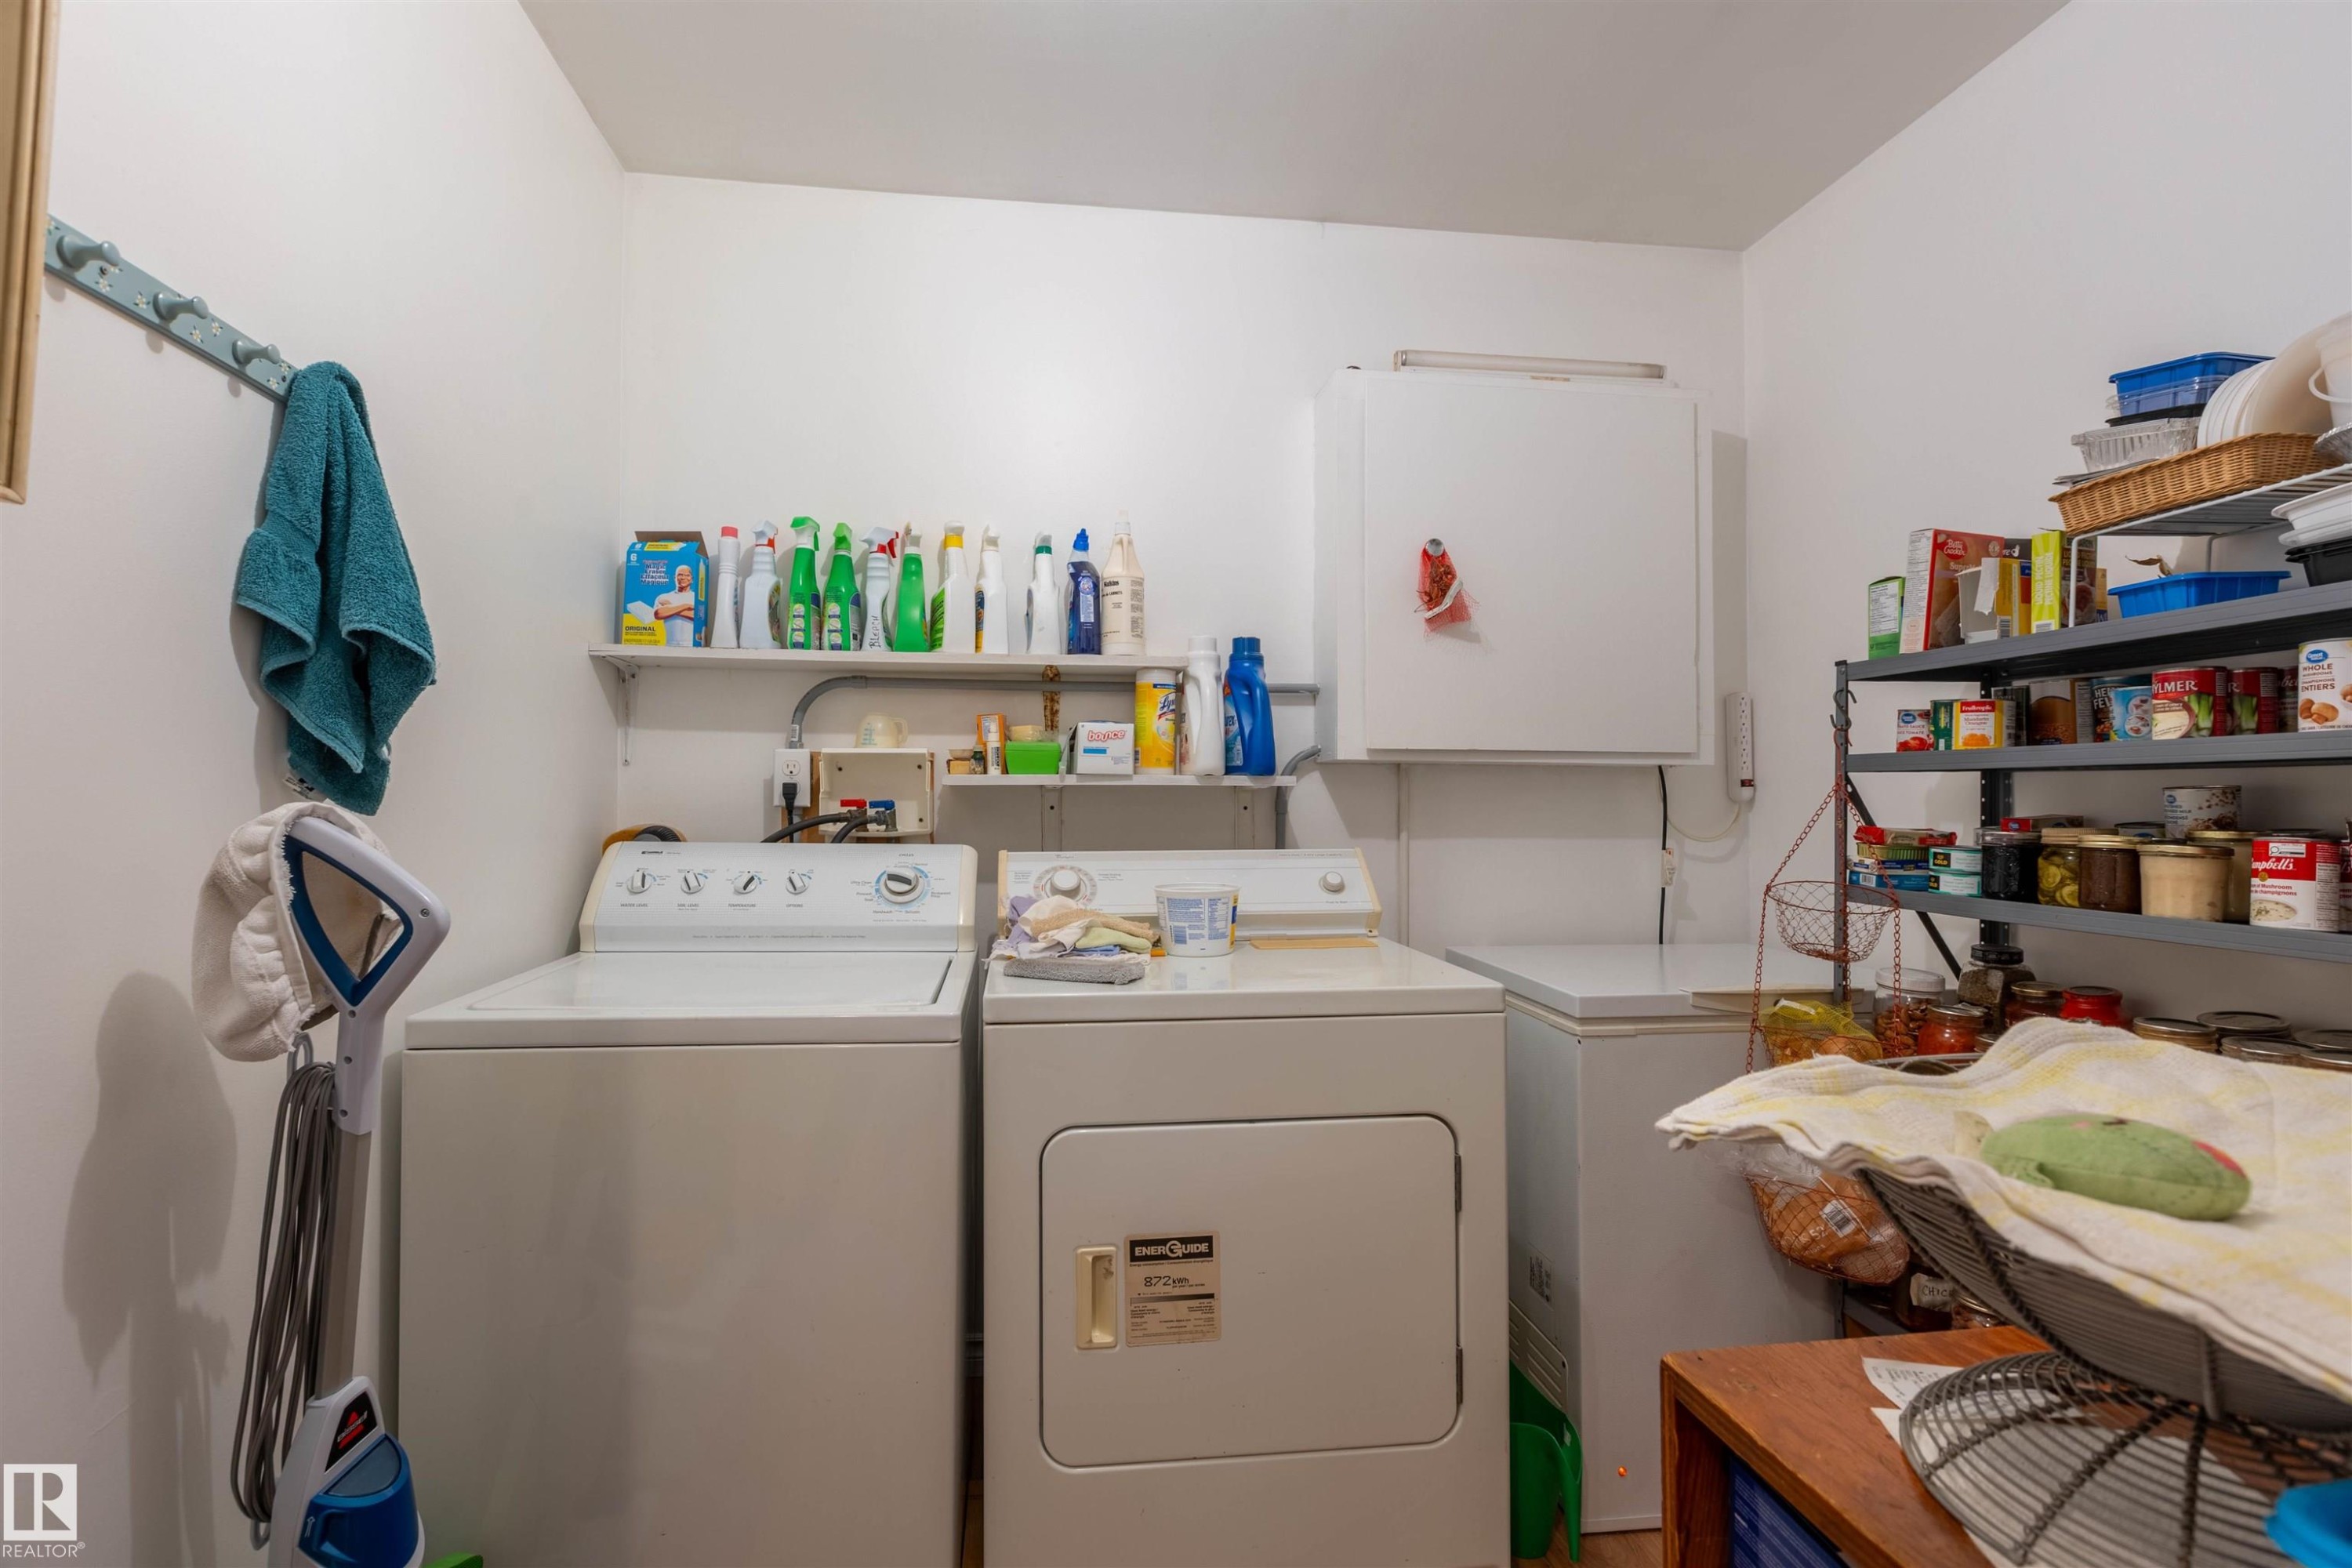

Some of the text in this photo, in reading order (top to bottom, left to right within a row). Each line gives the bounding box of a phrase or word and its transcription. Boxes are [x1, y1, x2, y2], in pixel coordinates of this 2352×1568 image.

[1947, 539, 1964, 548] Betty
[868, 615, 881, 649] BLEACH
[2302, 663, 2333, 672] WHOLE
[2302, 683, 2336, 692] ENTIERS
[1087, 729, 1126, 742] bounce
[1134, 1240, 1209, 1258] ENERGUIDE
[1144, 1276, 1171, 1287] 872
